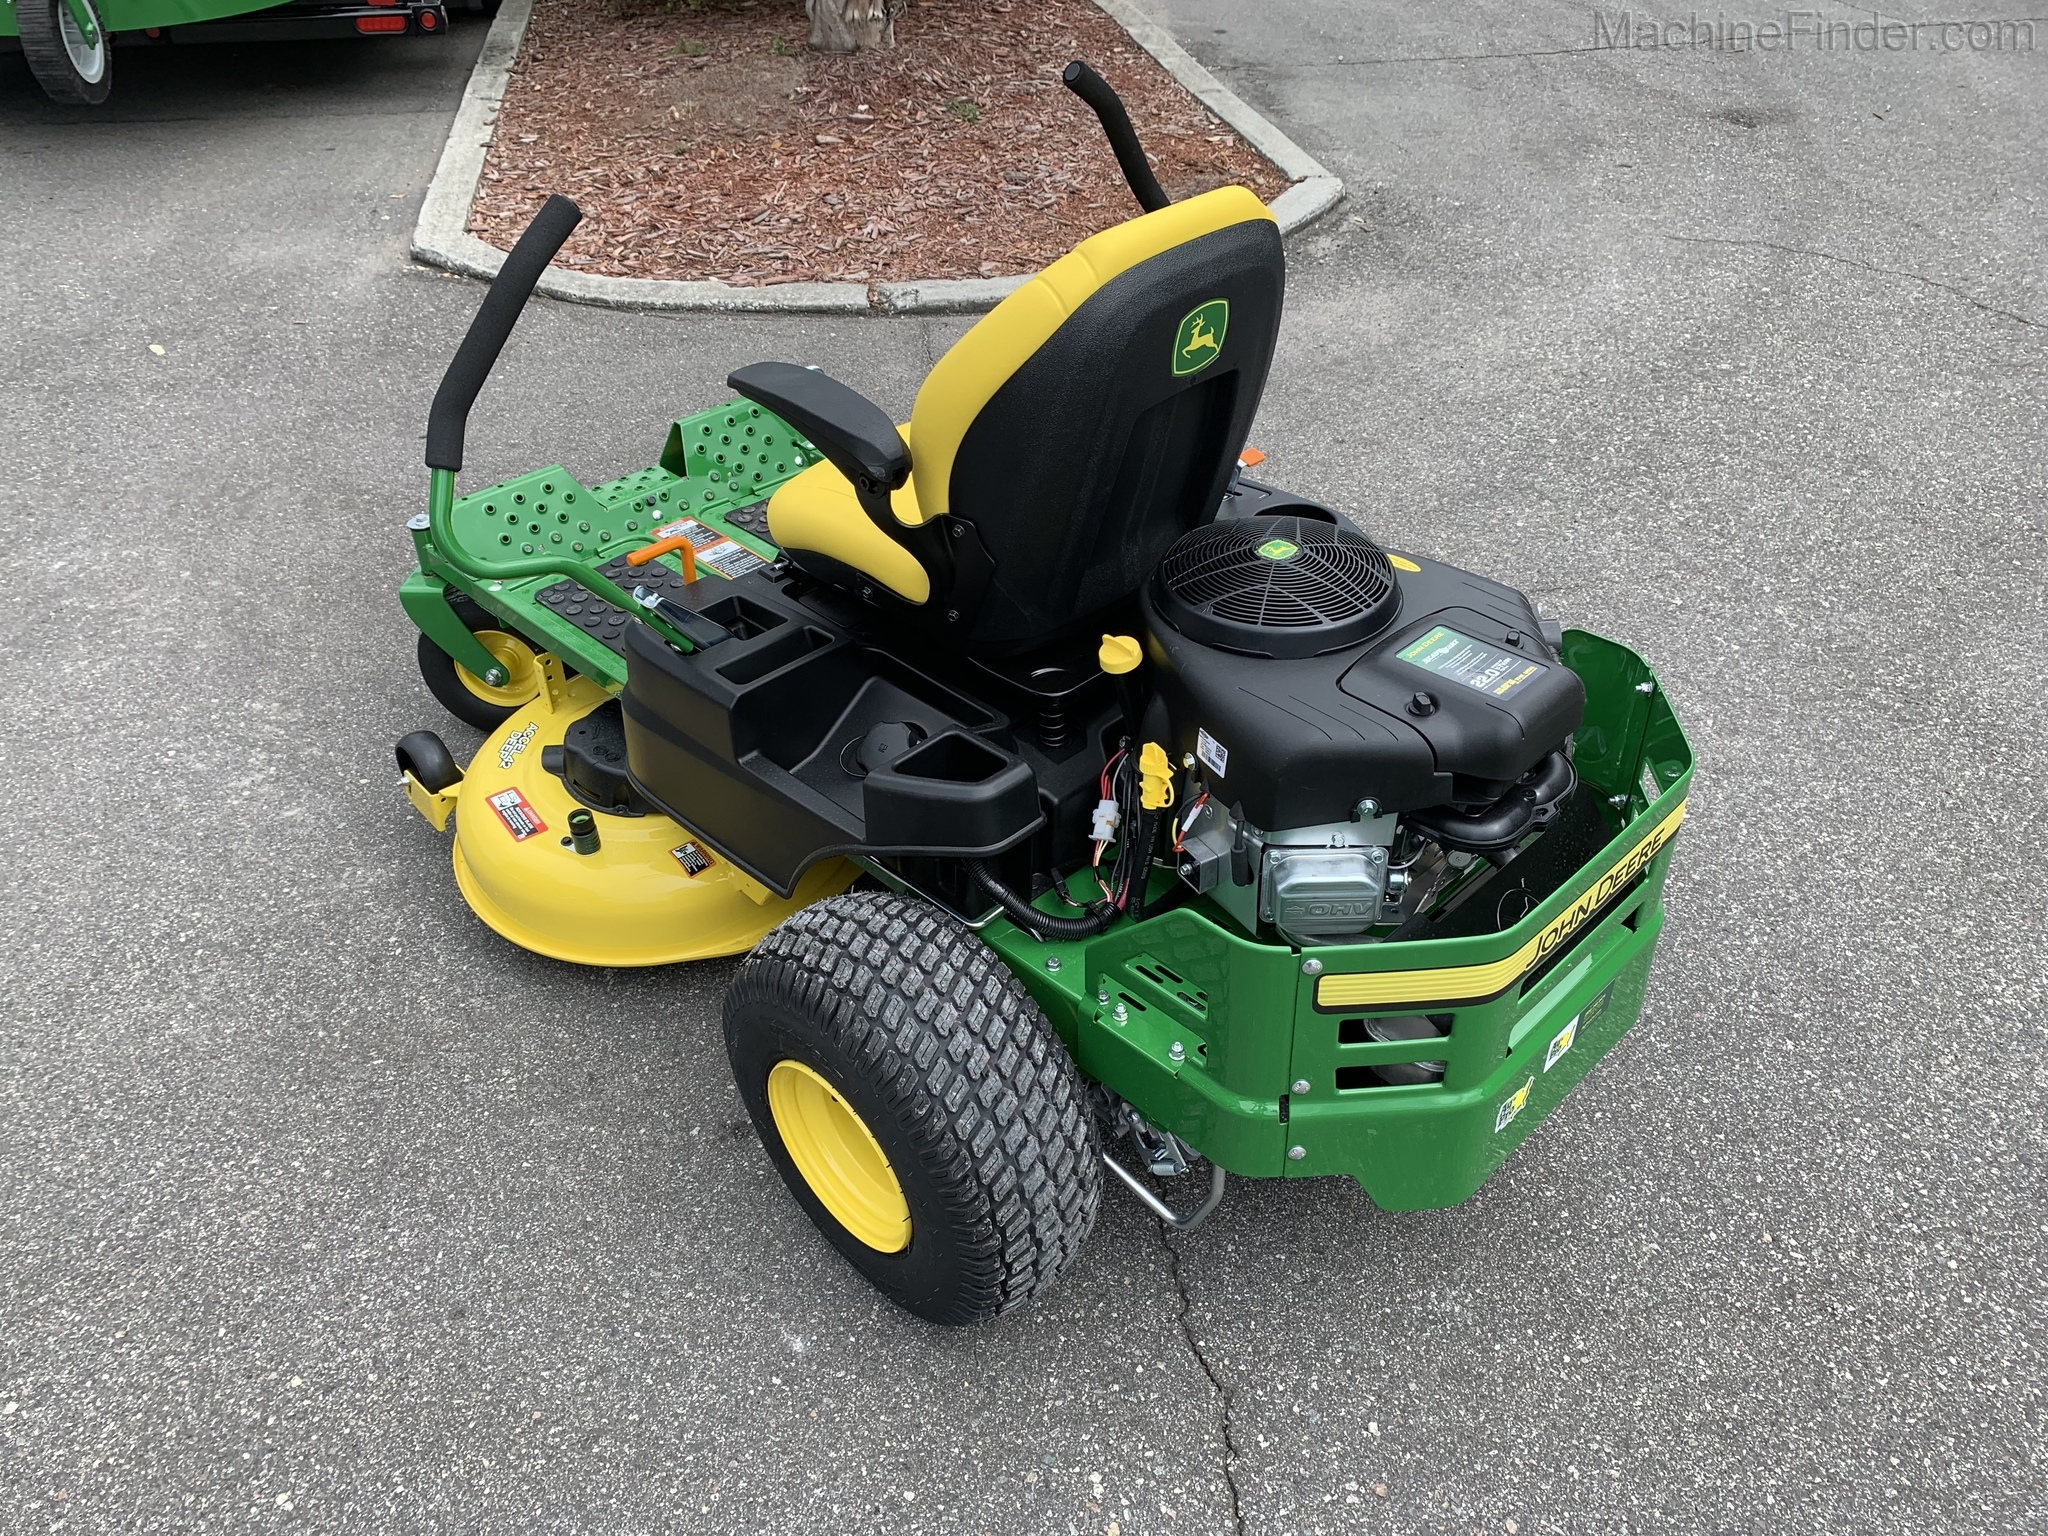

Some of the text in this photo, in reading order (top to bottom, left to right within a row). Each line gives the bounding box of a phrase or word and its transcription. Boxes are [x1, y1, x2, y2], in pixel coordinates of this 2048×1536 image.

[1406, 645, 1425, 658] JOHN
[1421, 631, 1444, 648] DEERE
[498, 730, 522, 760] DEEP
[509, 721, 539, 756] ACCEL
[1308, 902, 1373, 915] OHV
[1526, 828, 1665, 968] JOHN DEERE
